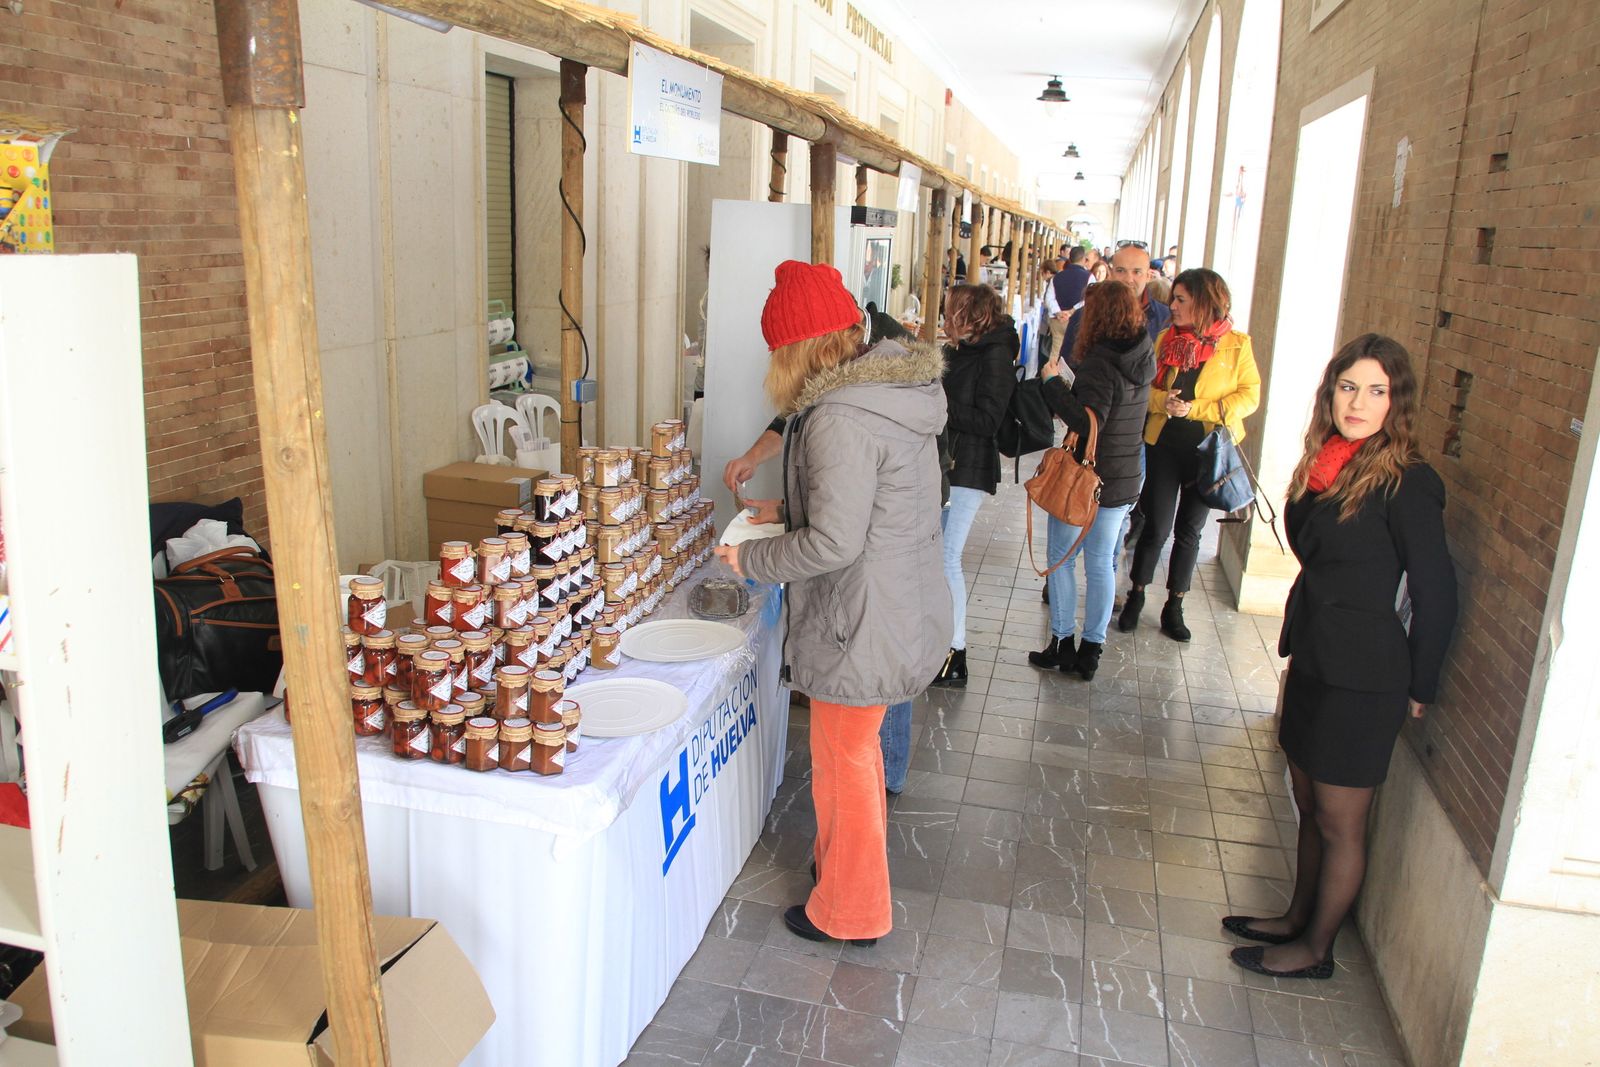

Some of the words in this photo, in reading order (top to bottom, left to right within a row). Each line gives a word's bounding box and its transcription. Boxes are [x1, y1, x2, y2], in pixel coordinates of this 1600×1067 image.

[661, 79, 669, 94] EL
[669, 82, 702, 103] MONUMENTO
[694, 762, 710, 806] DE
[711, 702, 757, 778] HUELVA
